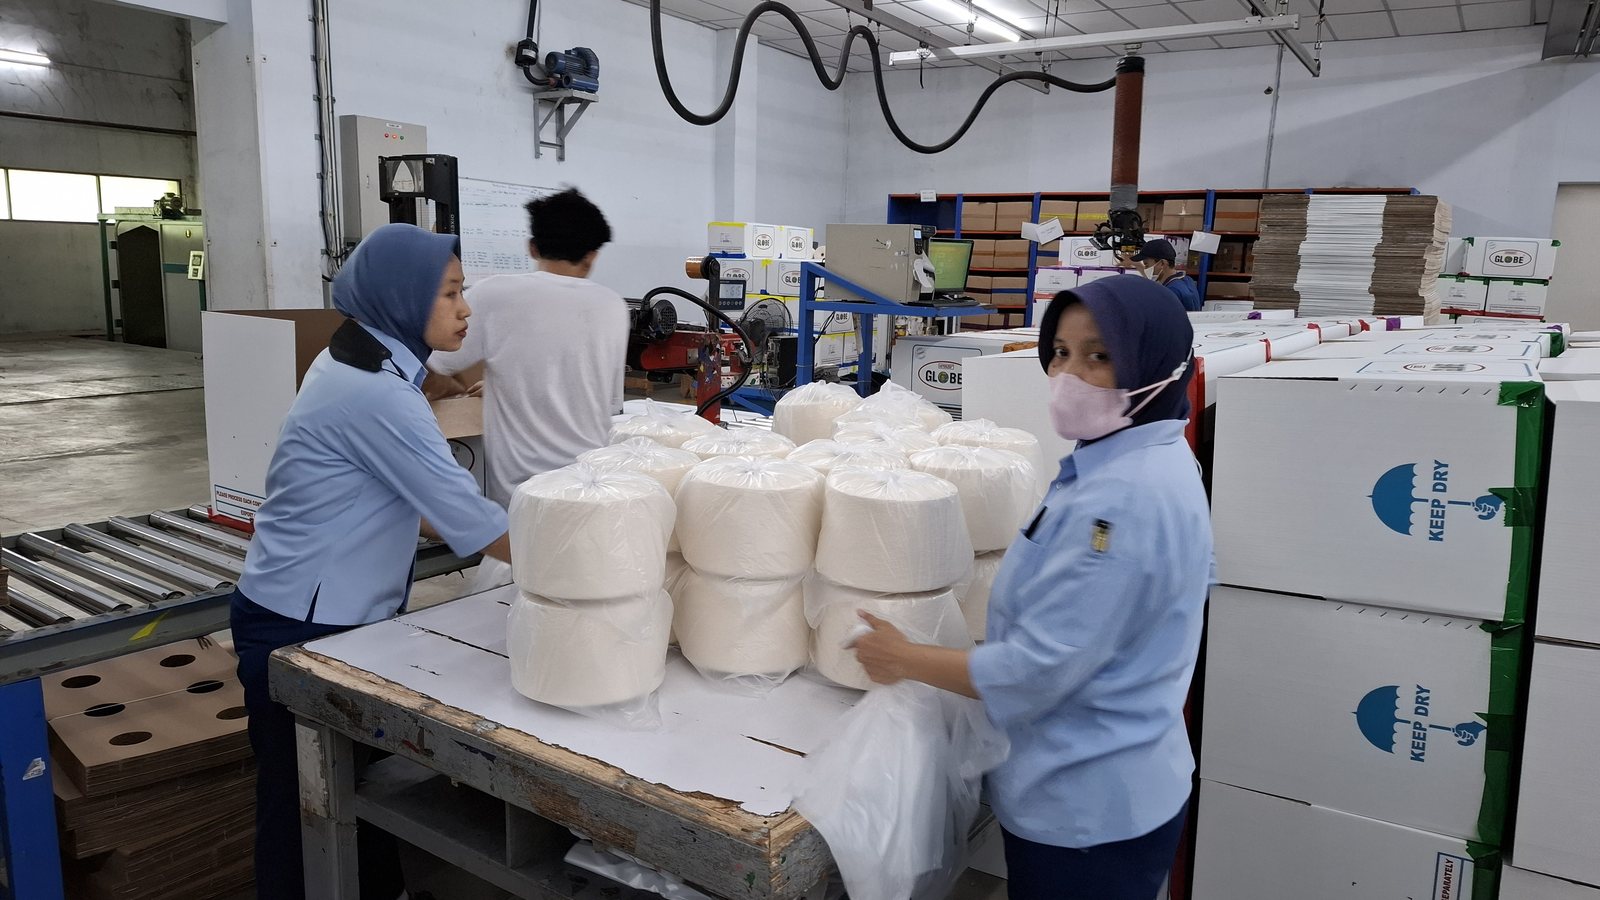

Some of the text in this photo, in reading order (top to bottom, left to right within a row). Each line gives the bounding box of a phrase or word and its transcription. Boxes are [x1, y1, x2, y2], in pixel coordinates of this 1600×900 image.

[757, 239, 770, 247] GLOBE
[1494, 255, 1524, 264] GLOBE
[925, 370, 962, 385] GLOBE
[228, 494, 242, 502] PROCESS
[1428, 459, 1449, 542] KEEP DRY
[1410, 683, 1431, 763] KEEP DRY
